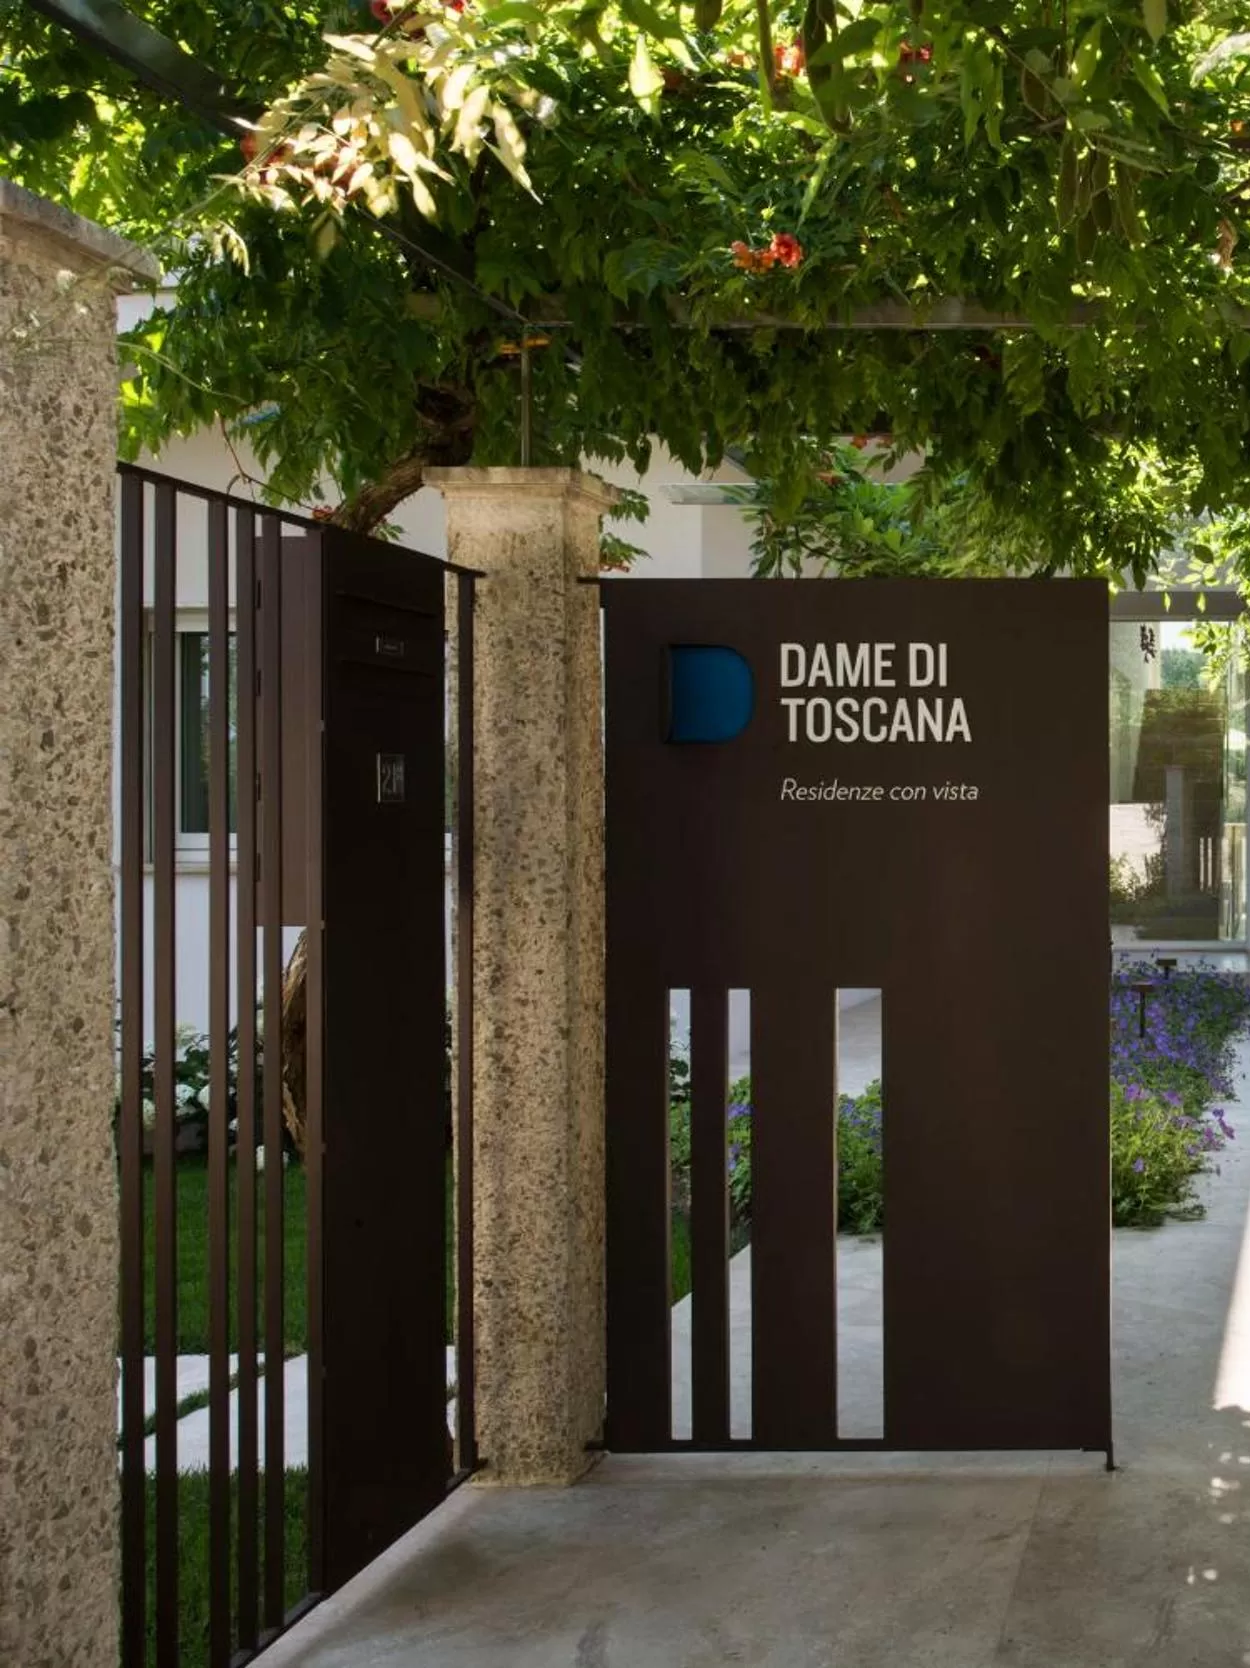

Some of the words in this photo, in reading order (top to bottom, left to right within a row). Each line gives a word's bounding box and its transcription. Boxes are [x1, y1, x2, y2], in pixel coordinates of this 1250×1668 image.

[780, 642, 897, 688] DAME
[908, 642, 948, 688] DI
[779, 696, 973, 744] TOSCANA
[780, 777, 885, 801] Residenze
[888, 785, 927, 801] con
[932, 780, 980, 801] vista
